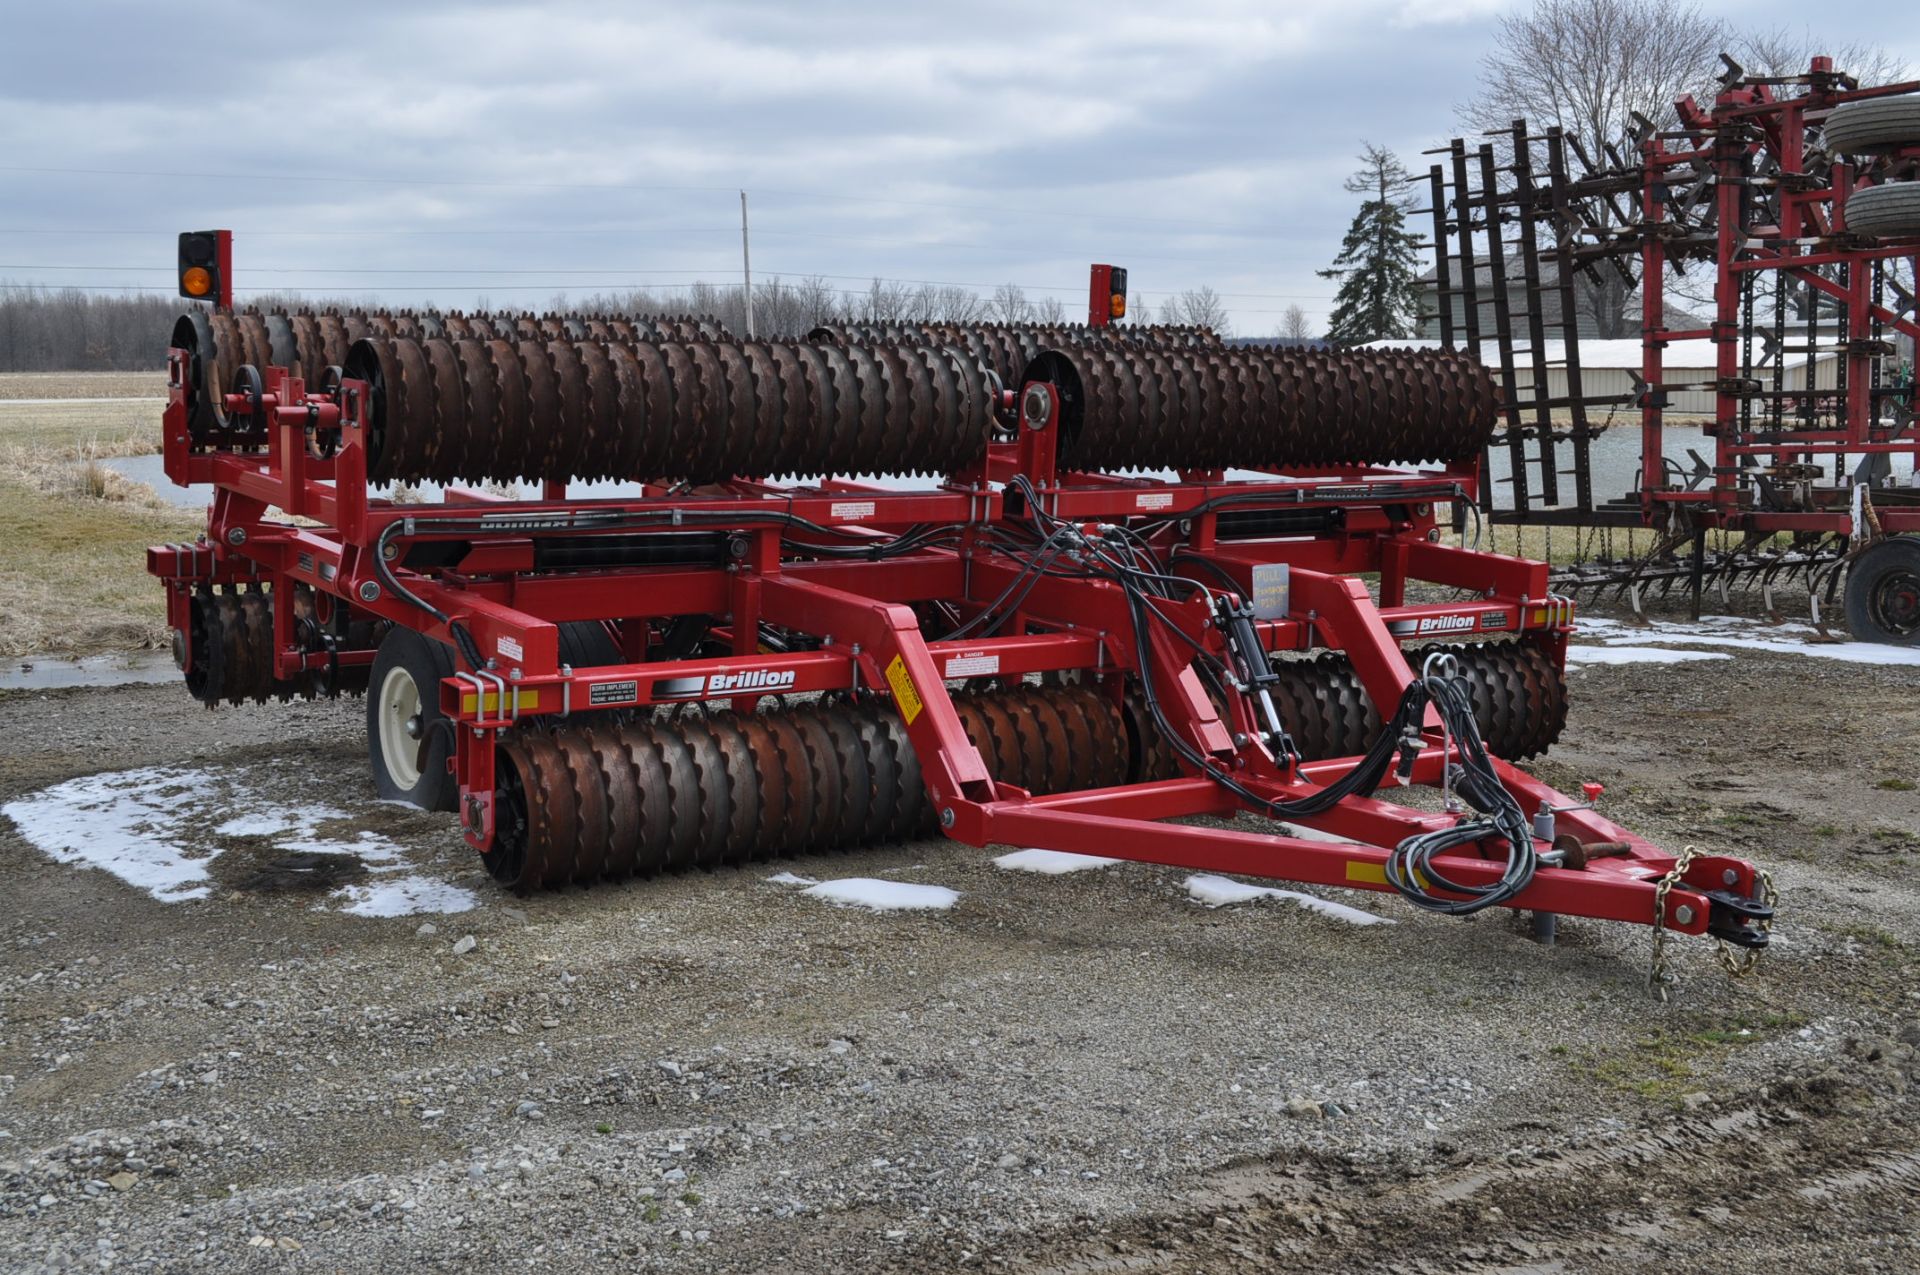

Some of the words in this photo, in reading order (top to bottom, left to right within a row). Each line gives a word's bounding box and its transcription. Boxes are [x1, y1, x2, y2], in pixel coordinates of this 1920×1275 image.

[1256, 569, 1281, 582] PULL
[1420, 614, 1475, 630] Brillion
[708, 670, 795, 690] Brillion
[903, 672, 921, 706] CAUTION
